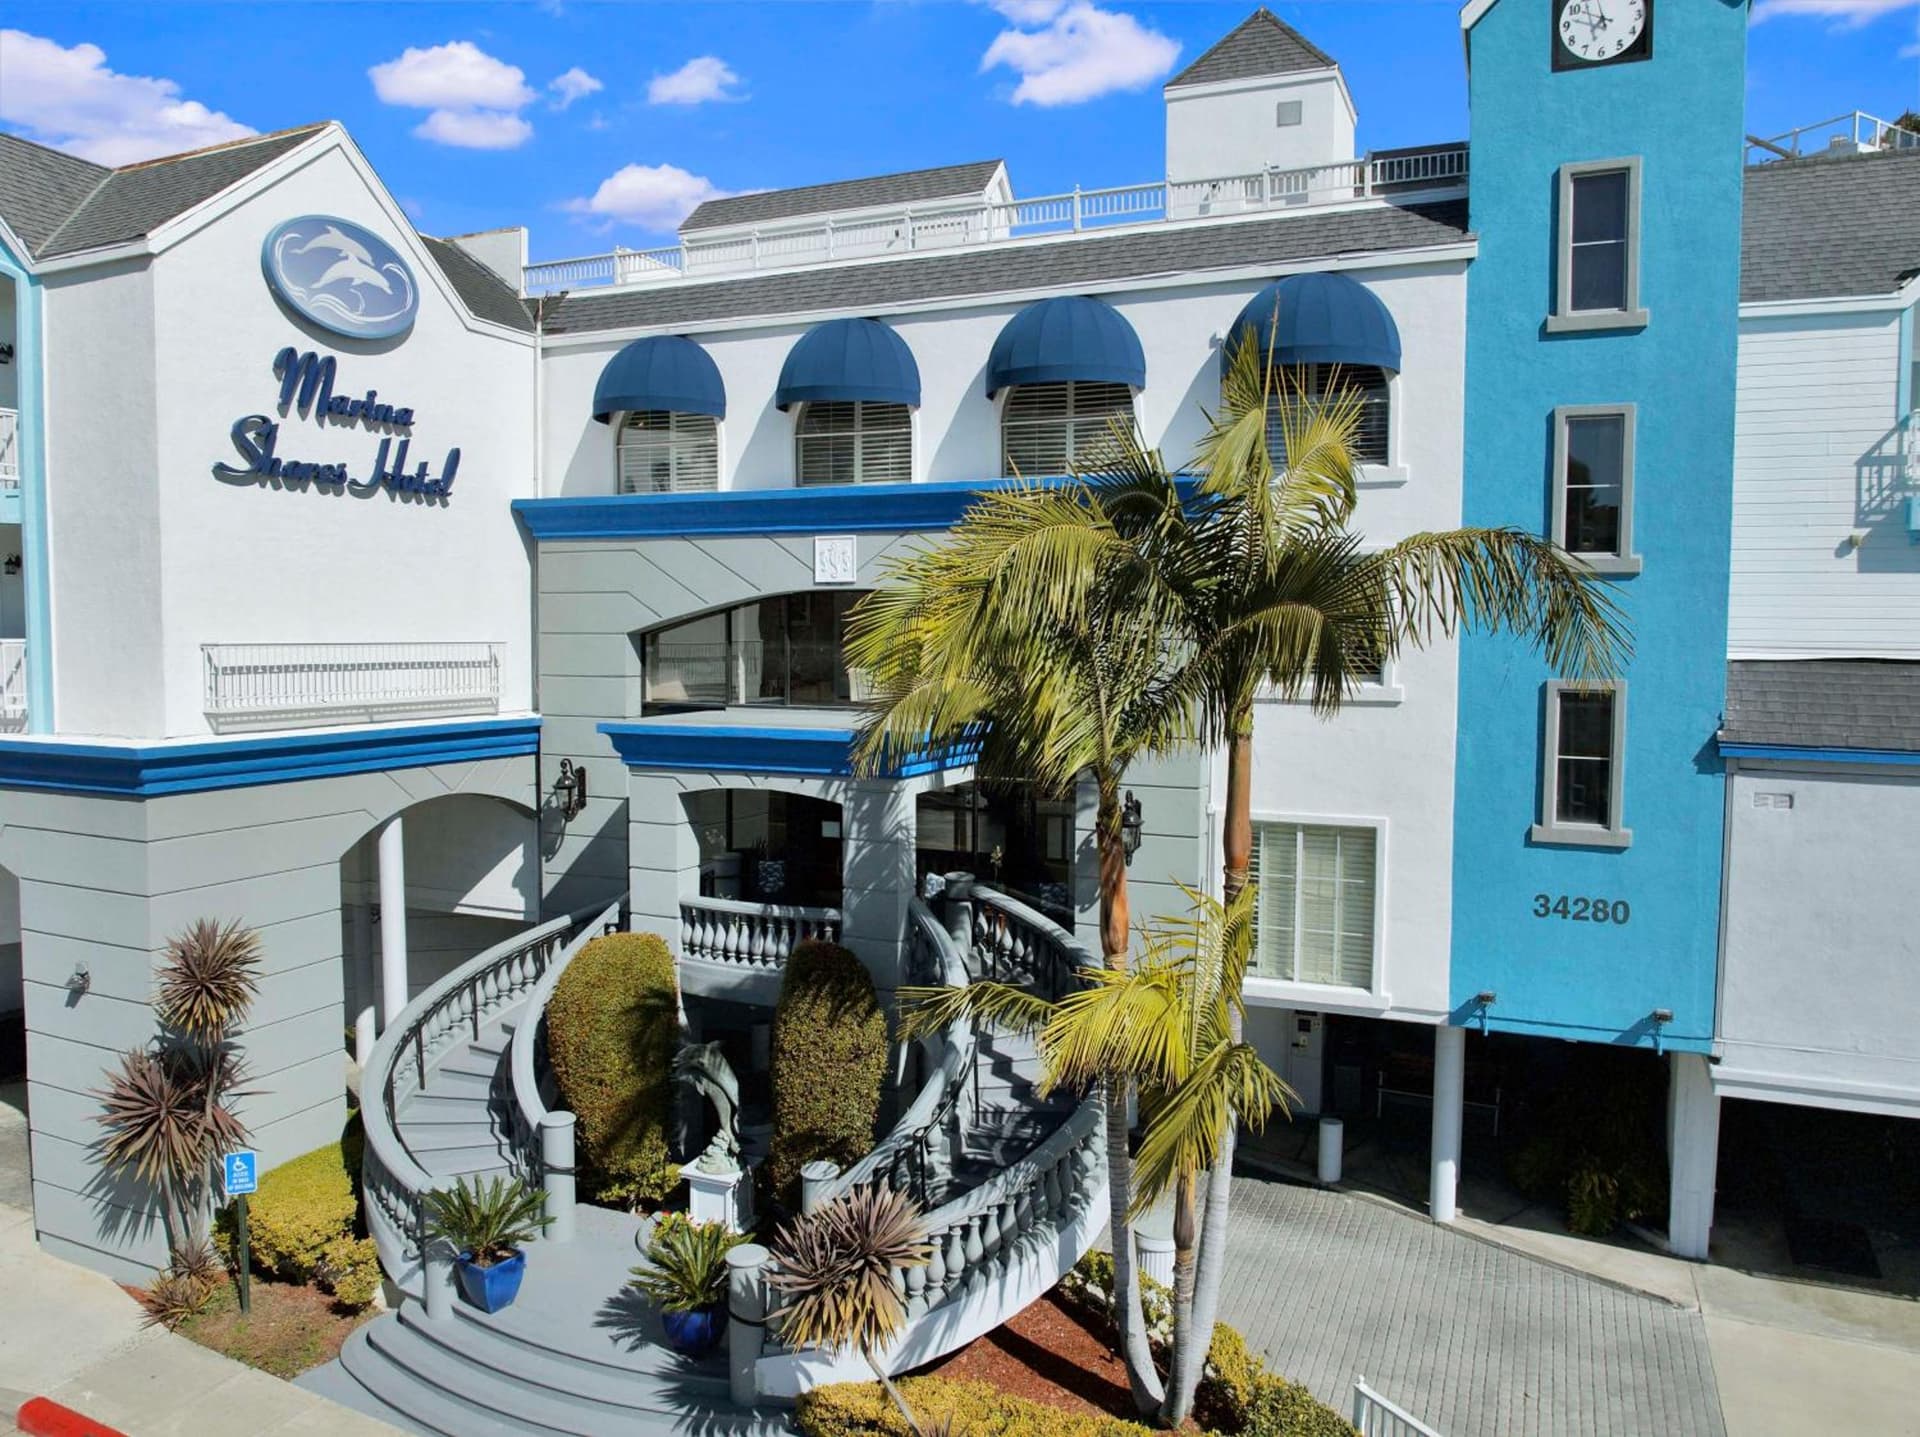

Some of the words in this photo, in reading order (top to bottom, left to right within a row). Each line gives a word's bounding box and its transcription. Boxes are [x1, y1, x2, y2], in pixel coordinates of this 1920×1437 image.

[1569, 4, 1580, 16] 10
[1634, 9, 1642, 21] 3
[1563, 21, 1570, 32] 9
[1629, 26, 1636, 36] 4
[1568, 35, 1575, 46] 8
[1616, 39, 1623, 50] 5
[1581, 45, 1589, 55] 7
[1597, 47, 1605, 57] 6
[272, 346, 415, 428] Marina
[212, 415, 347, 486] Shores
[348, 438, 461, 497] Hotel
[1533, 894, 1630, 925] 34280
